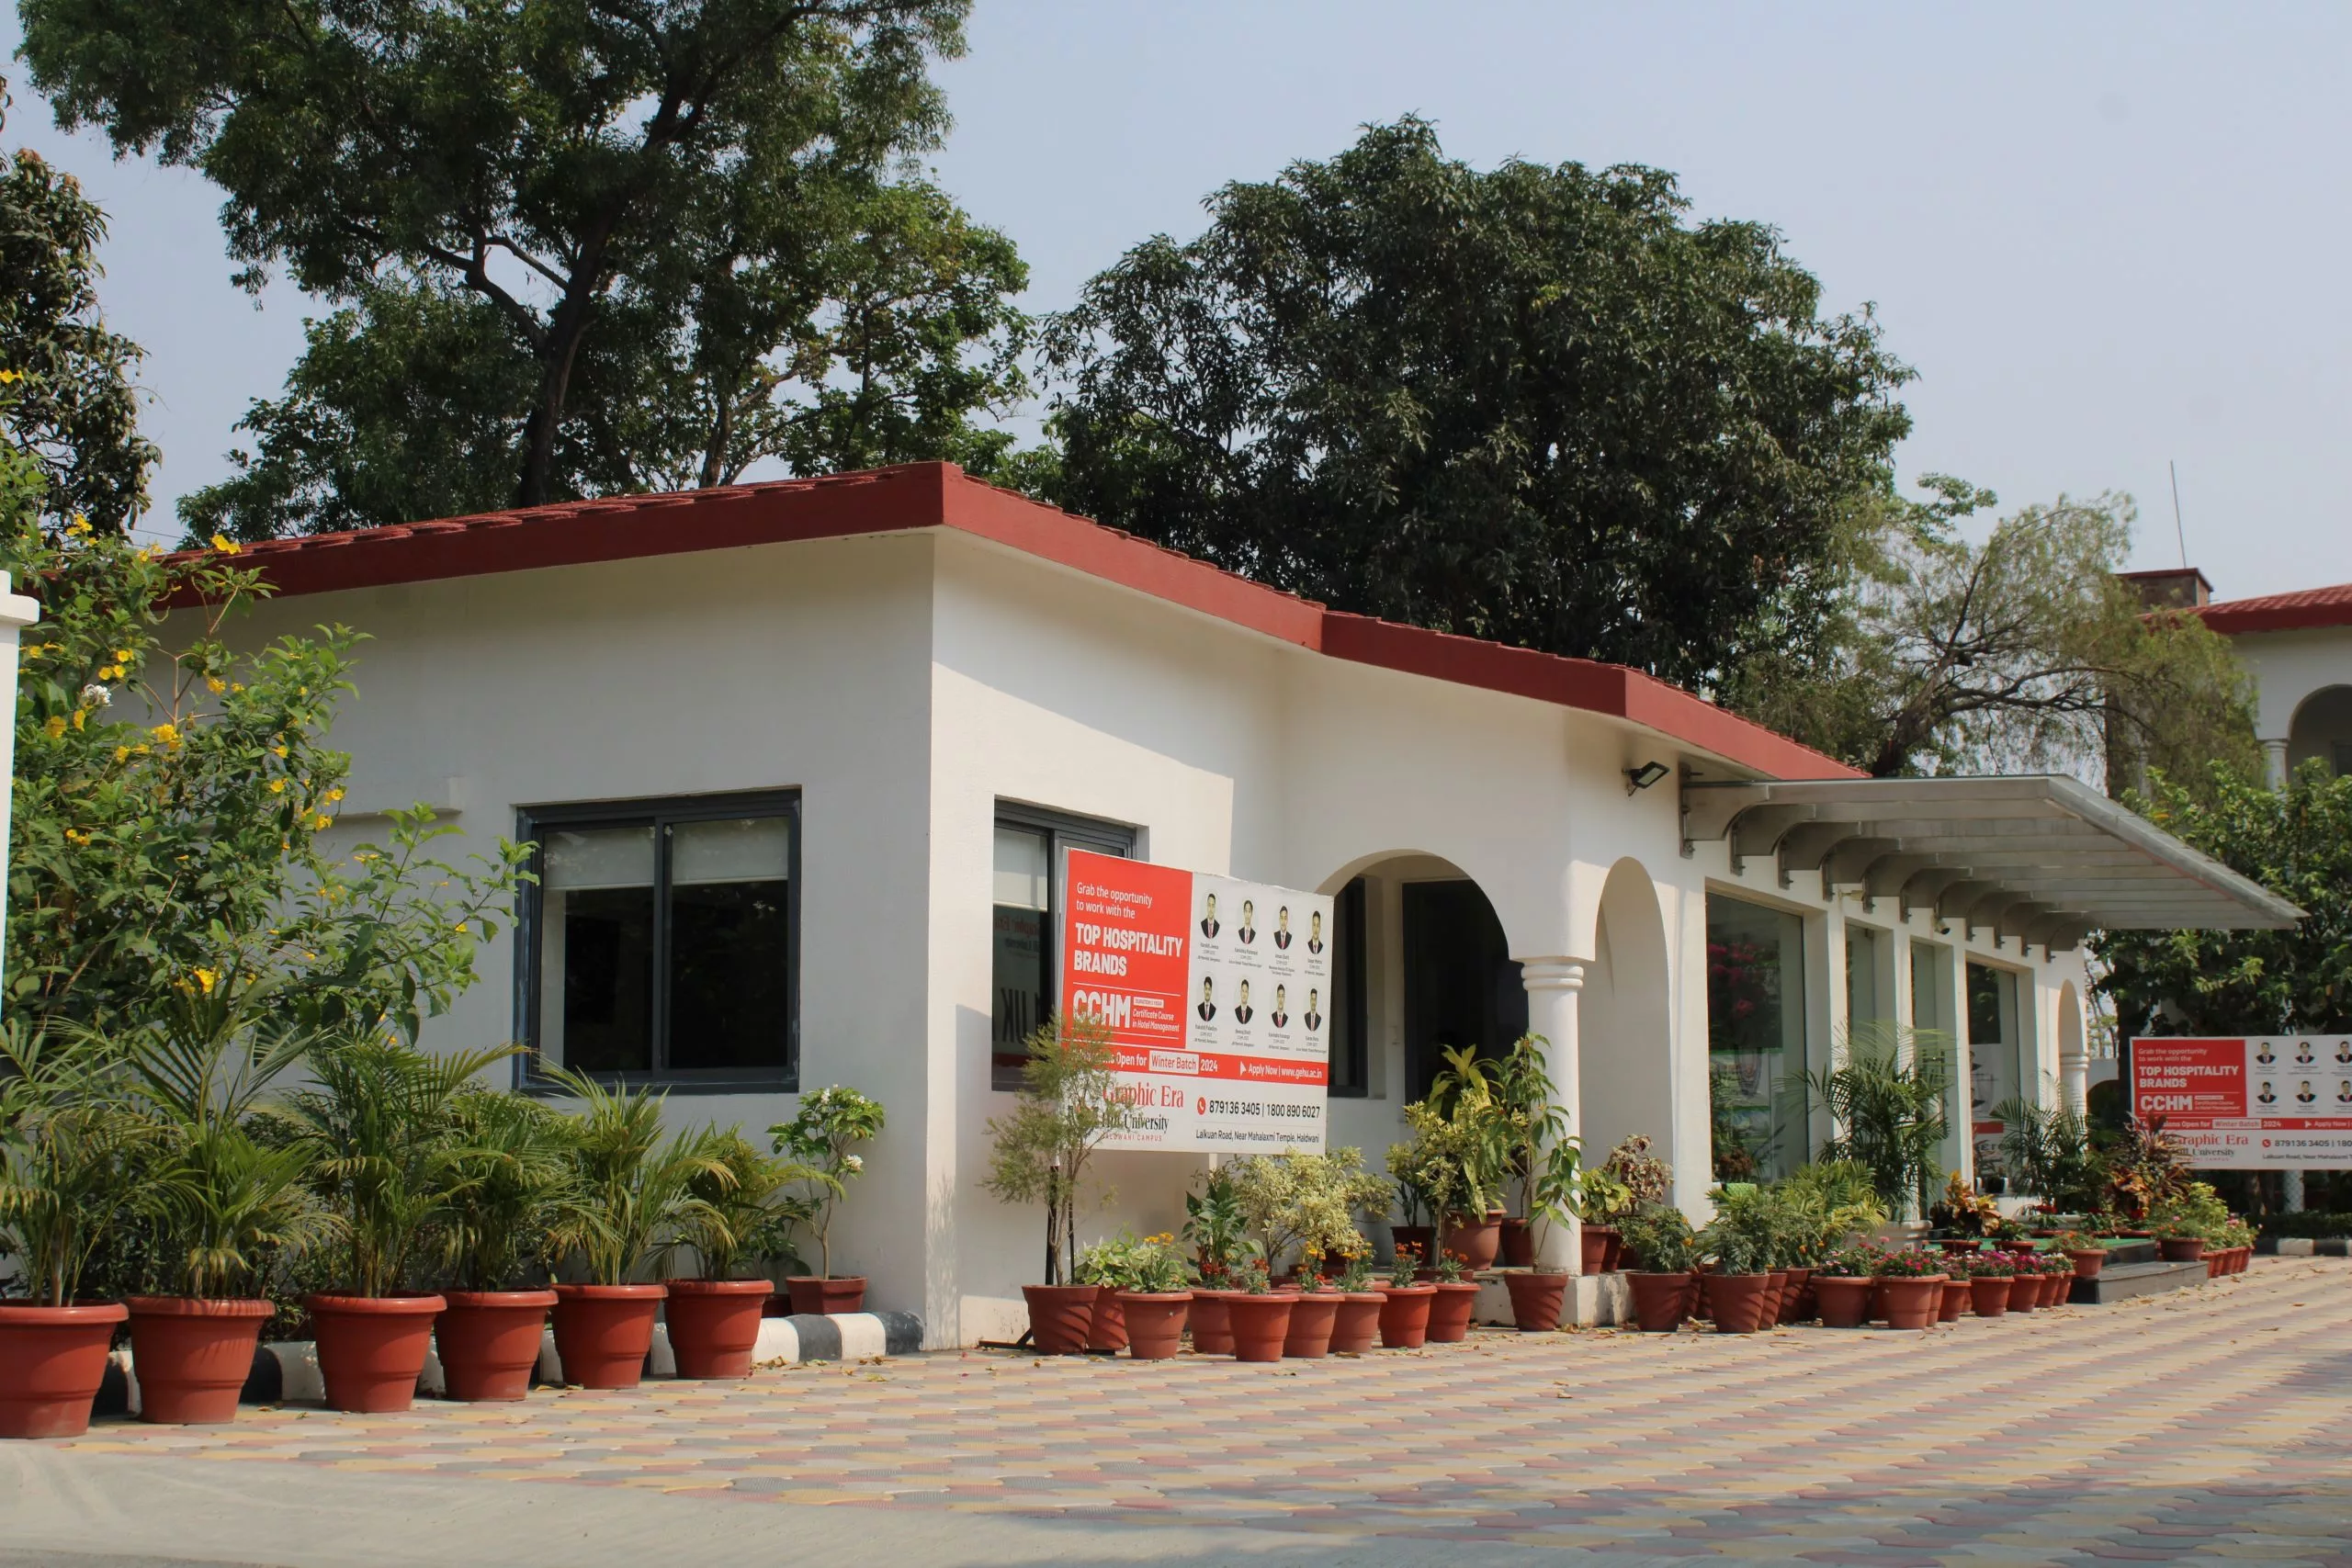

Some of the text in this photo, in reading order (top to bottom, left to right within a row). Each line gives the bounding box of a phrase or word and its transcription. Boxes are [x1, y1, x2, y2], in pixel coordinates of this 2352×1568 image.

[1077, 882, 1153, 908] Grab the opportunity
[1076, 900, 1136, 919] to work with the
[1075, 922, 1183, 957] TOP HOSPITALITY
[1073, 950, 1127, 976] BRANDS
[1073, 989, 1132, 1029] CCHM
[1133, 1009, 1174, 1021] Certificate Course
[1150, 1021, 1180, 1032] Management
[2168, 1048, 2208, 1056] opportunity
[1116, 1051, 1135, 1067] Open
[1136, 1053, 1148, 1066] for
[1151, 1055, 1176, 1068] Winter
[1176, 1059, 1196, 1070] Batch
[1200, 1058, 1218, 1073] 2024
[1248, 1063, 1265, 1077] Apply
[1265, 1064, 1278, 1076] Now
[1281, 1066, 1323, 1080] www.gehu.ac.in
[2139, 1065, 2239, 1077] TOP HOSPITALITY
[2139, 1077, 2188, 1089] BRANDS
[1160, 1085, 1184, 1109] Era
[2140, 1095, 2193, 1111] CCHM
[1209, 1100, 1239, 1114] 879136
[1240, 1102, 1261, 1116] 3405
[1266, 1103, 1285, 1117] 1800
[1286, 1104, 1301, 1118] 890
[1302, 1105, 1321, 1118] 6027
[1124, 1113, 1170, 1134] University
[2181, 1121, 2199, 1129] Open
[1136, 1134, 1162, 1142] CAMPUS
[1218, 1130, 1234, 1142] Road,
[1234, 1131, 1247, 1141] Near
[2226, 1134, 2249, 1145] Era
[2307, 1139, 2330, 1147] 3405
[2192, 1147, 2234, 1157] University
